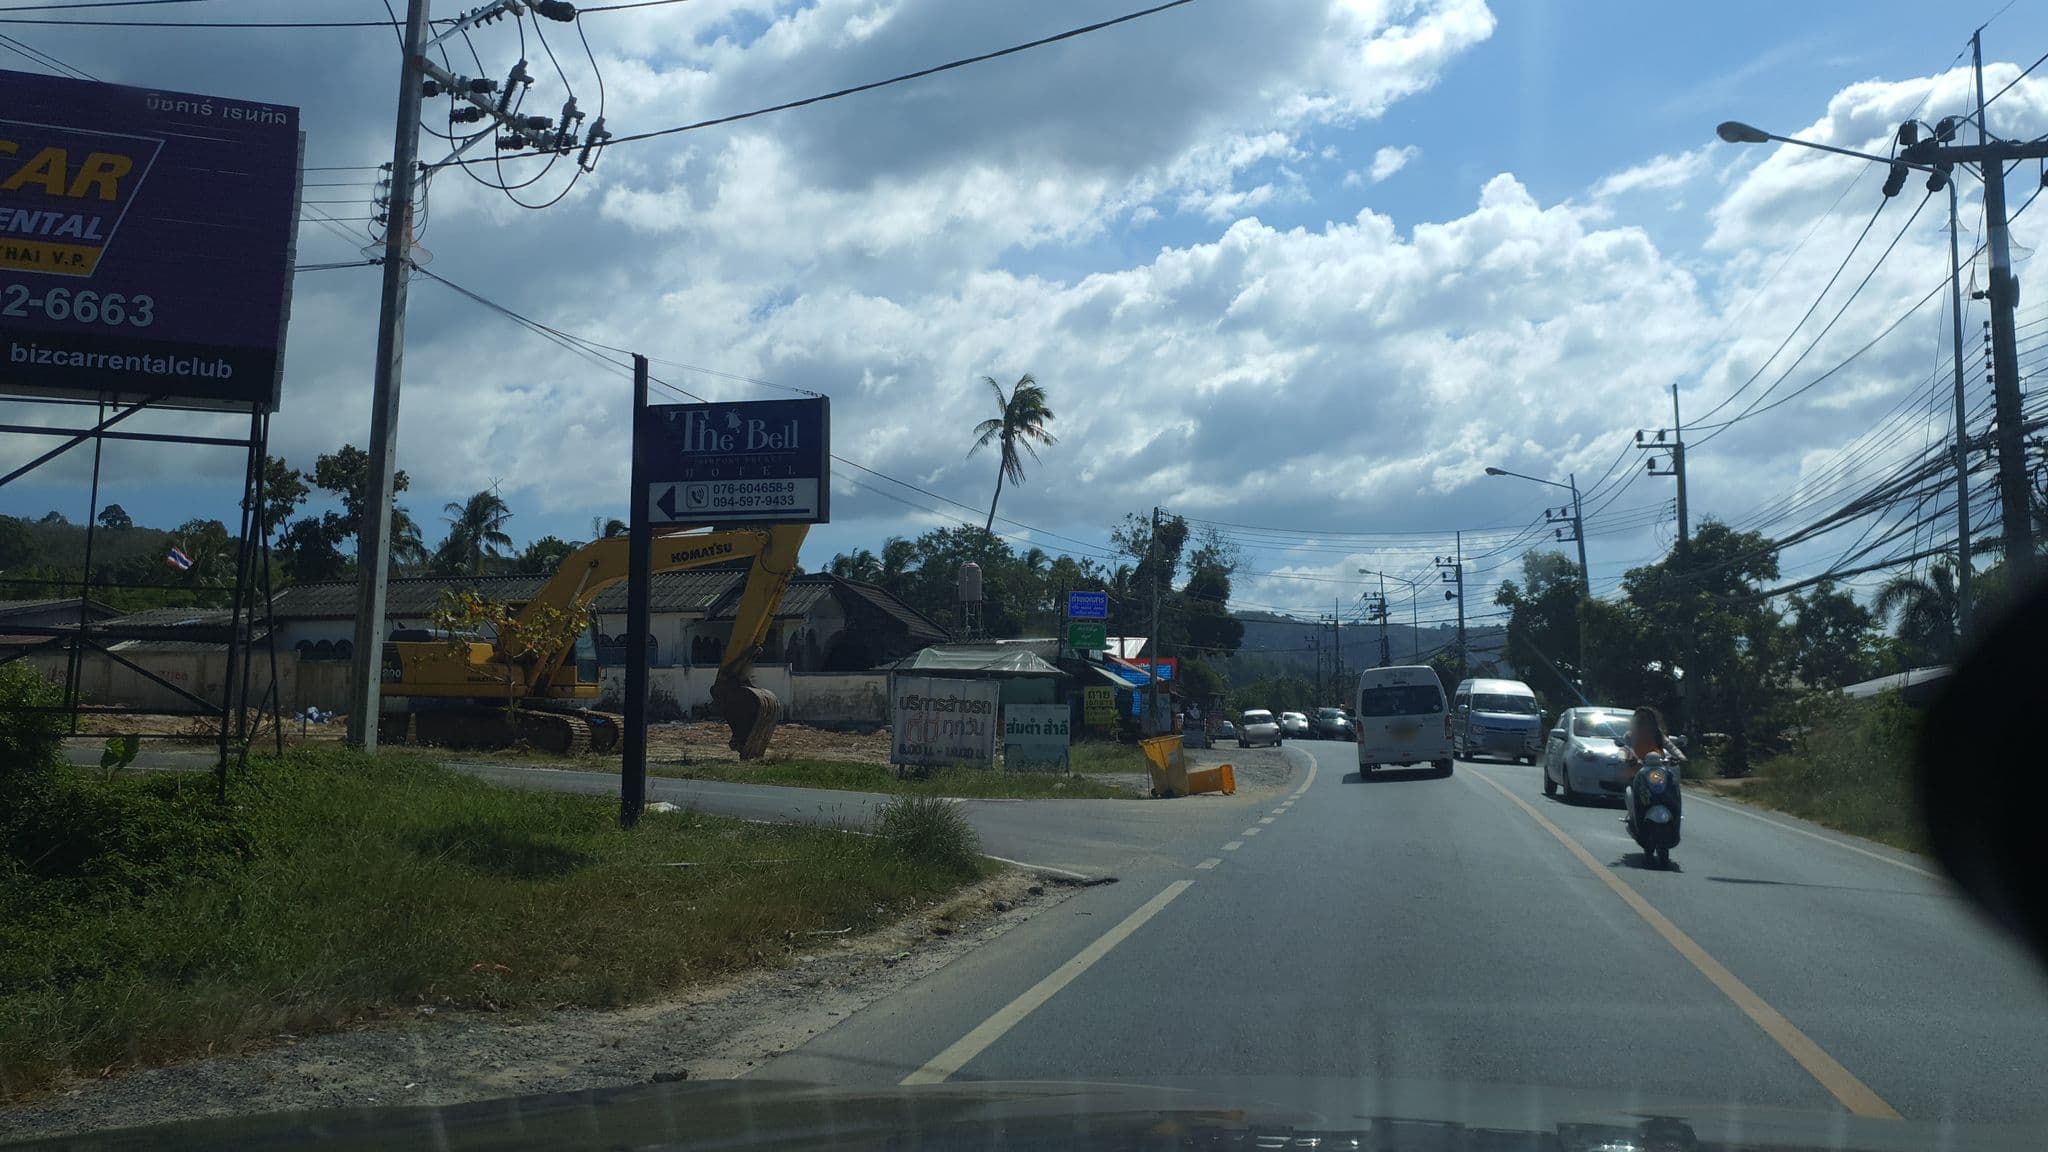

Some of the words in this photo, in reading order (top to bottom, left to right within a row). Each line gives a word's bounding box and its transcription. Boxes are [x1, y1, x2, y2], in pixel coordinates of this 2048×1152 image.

[52, 250, 85, 268] V.P.
[0, 284, 155, 328] 2-6663
[11, 342, 233, 379] bizcarrentalclub
[670, 409, 734, 452] The
[747, 418, 799, 450] Bell
[713, 482, 795, 495] 076-604658-9
[713, 495, 795, 508] 094-597-9433
[672, 543, 732, 563] KOMATSU
